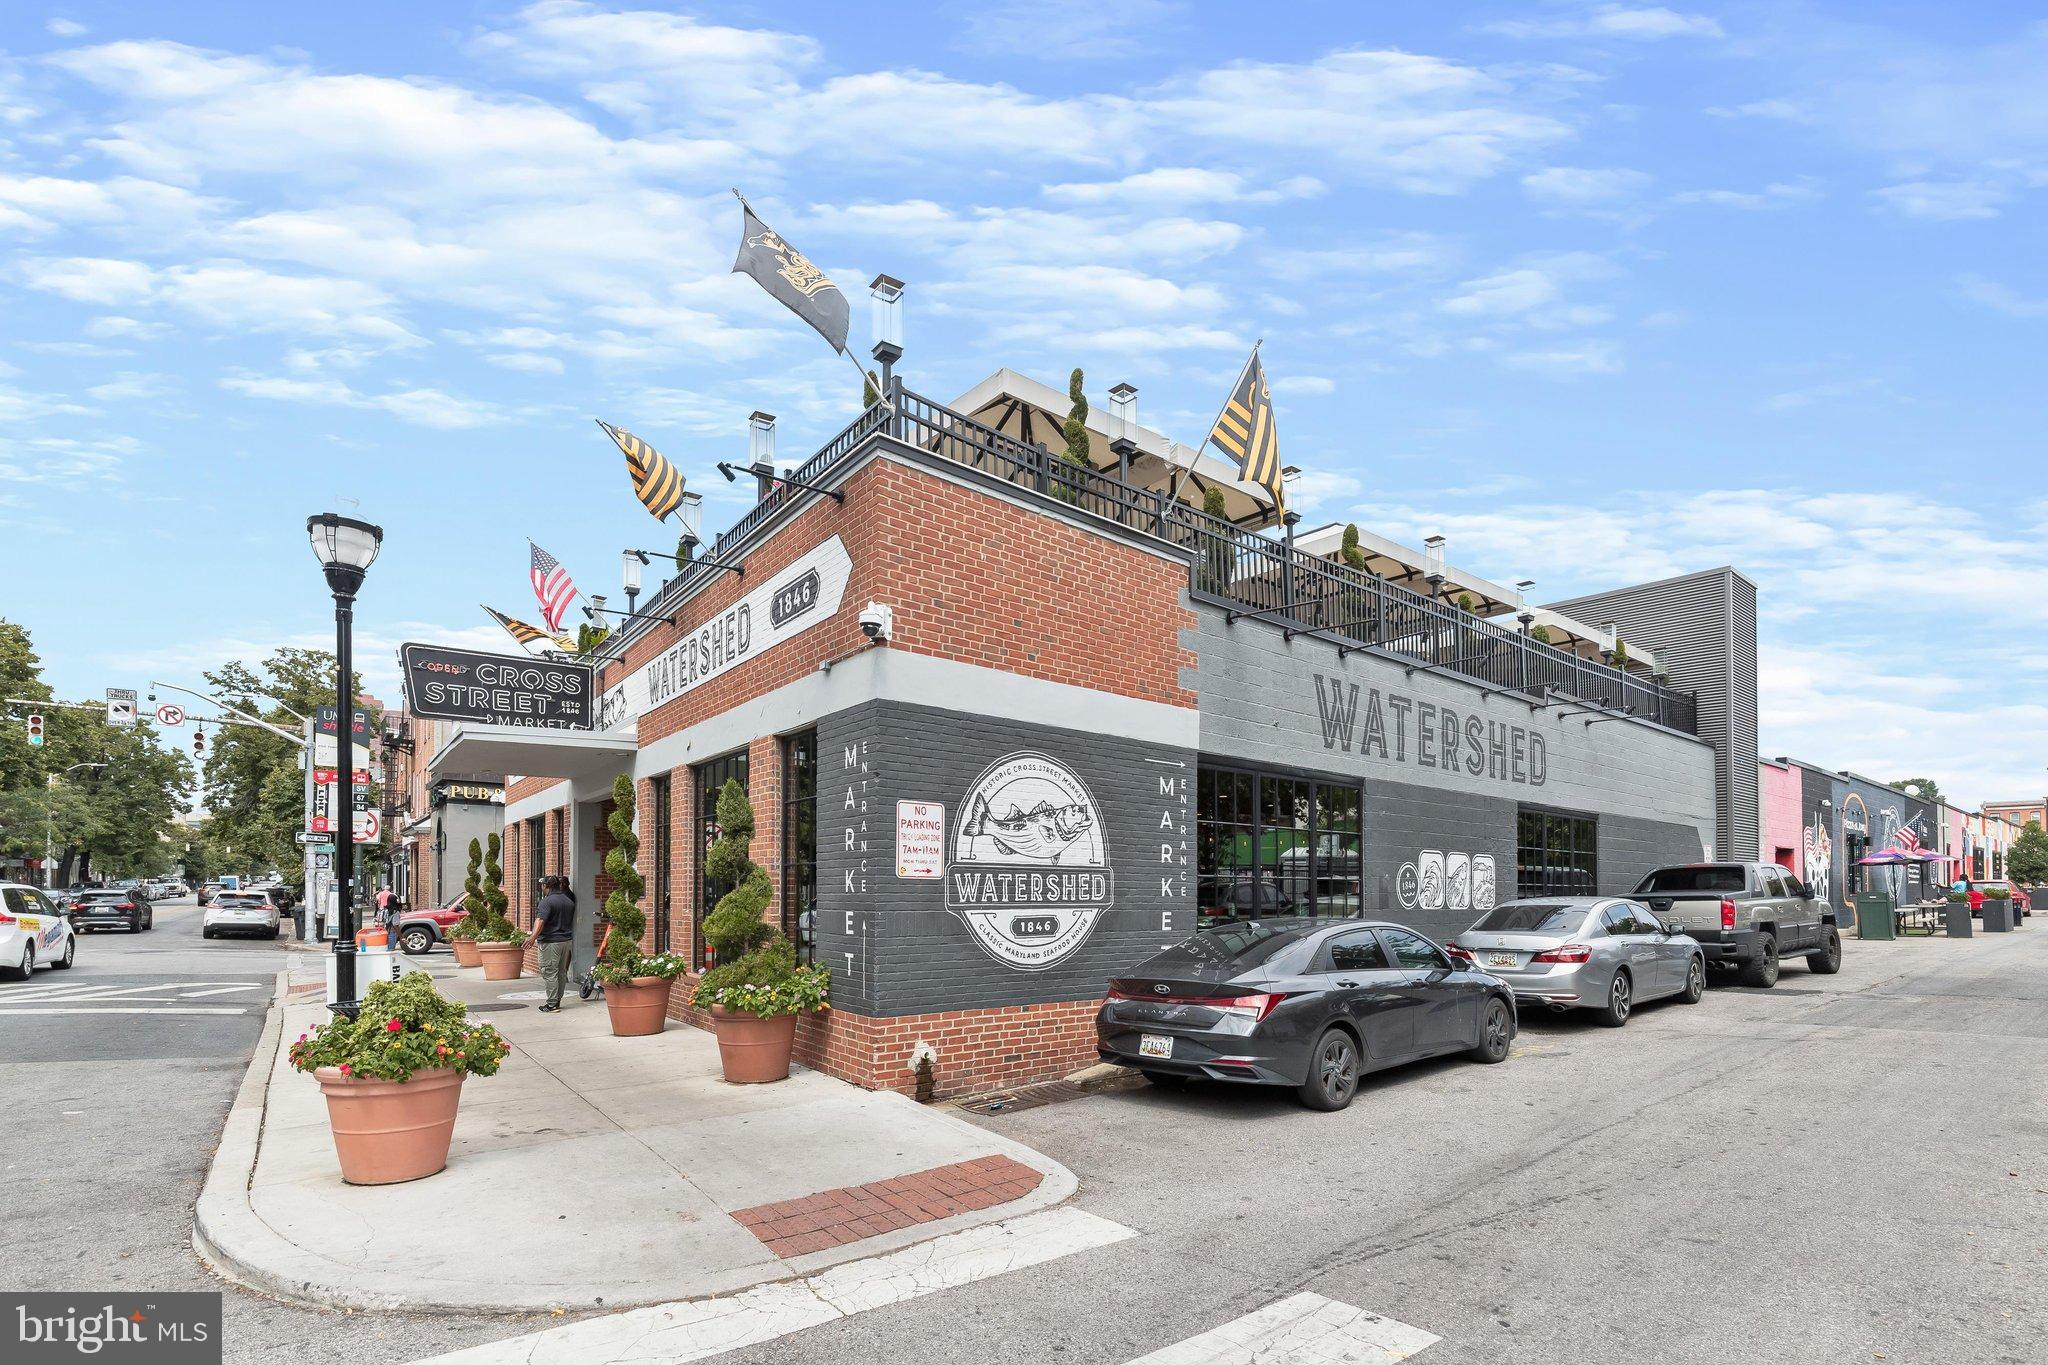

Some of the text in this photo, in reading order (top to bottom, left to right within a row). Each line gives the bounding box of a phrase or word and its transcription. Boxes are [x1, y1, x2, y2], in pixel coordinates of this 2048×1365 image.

[648, 582, 810, 704] WATERSHED 1846
[476, 664, 582, 694] CROSS
[425, 682, 552, 714] STREET
[322, 721, 364, 732] shle
[498, 715, 566, 730] MARKET
[1312, 674, 1546, 787] WATERSHED
[450, 785, 489, 799] PUB
[982, 764, 1086, 802] HISTORIC CROSS STREET MARKET
[901, 819, 940, 830] PARKING
[915, 806, 927, 816] NO
[844, 744, 857, 976] MARKET
[903, 844, 939, 855] 7AM-11AM
[1159, 776, 1174, 950] MARKE
[955, 872, 1106, 903] WATERSHED
[1402, 880, 1415, 890] 1846
[979, 918, 1088, 959] CLASSIC MARYLAND SEAFOOD HOUSE
[1020, 921, 1051, 932] 1846
